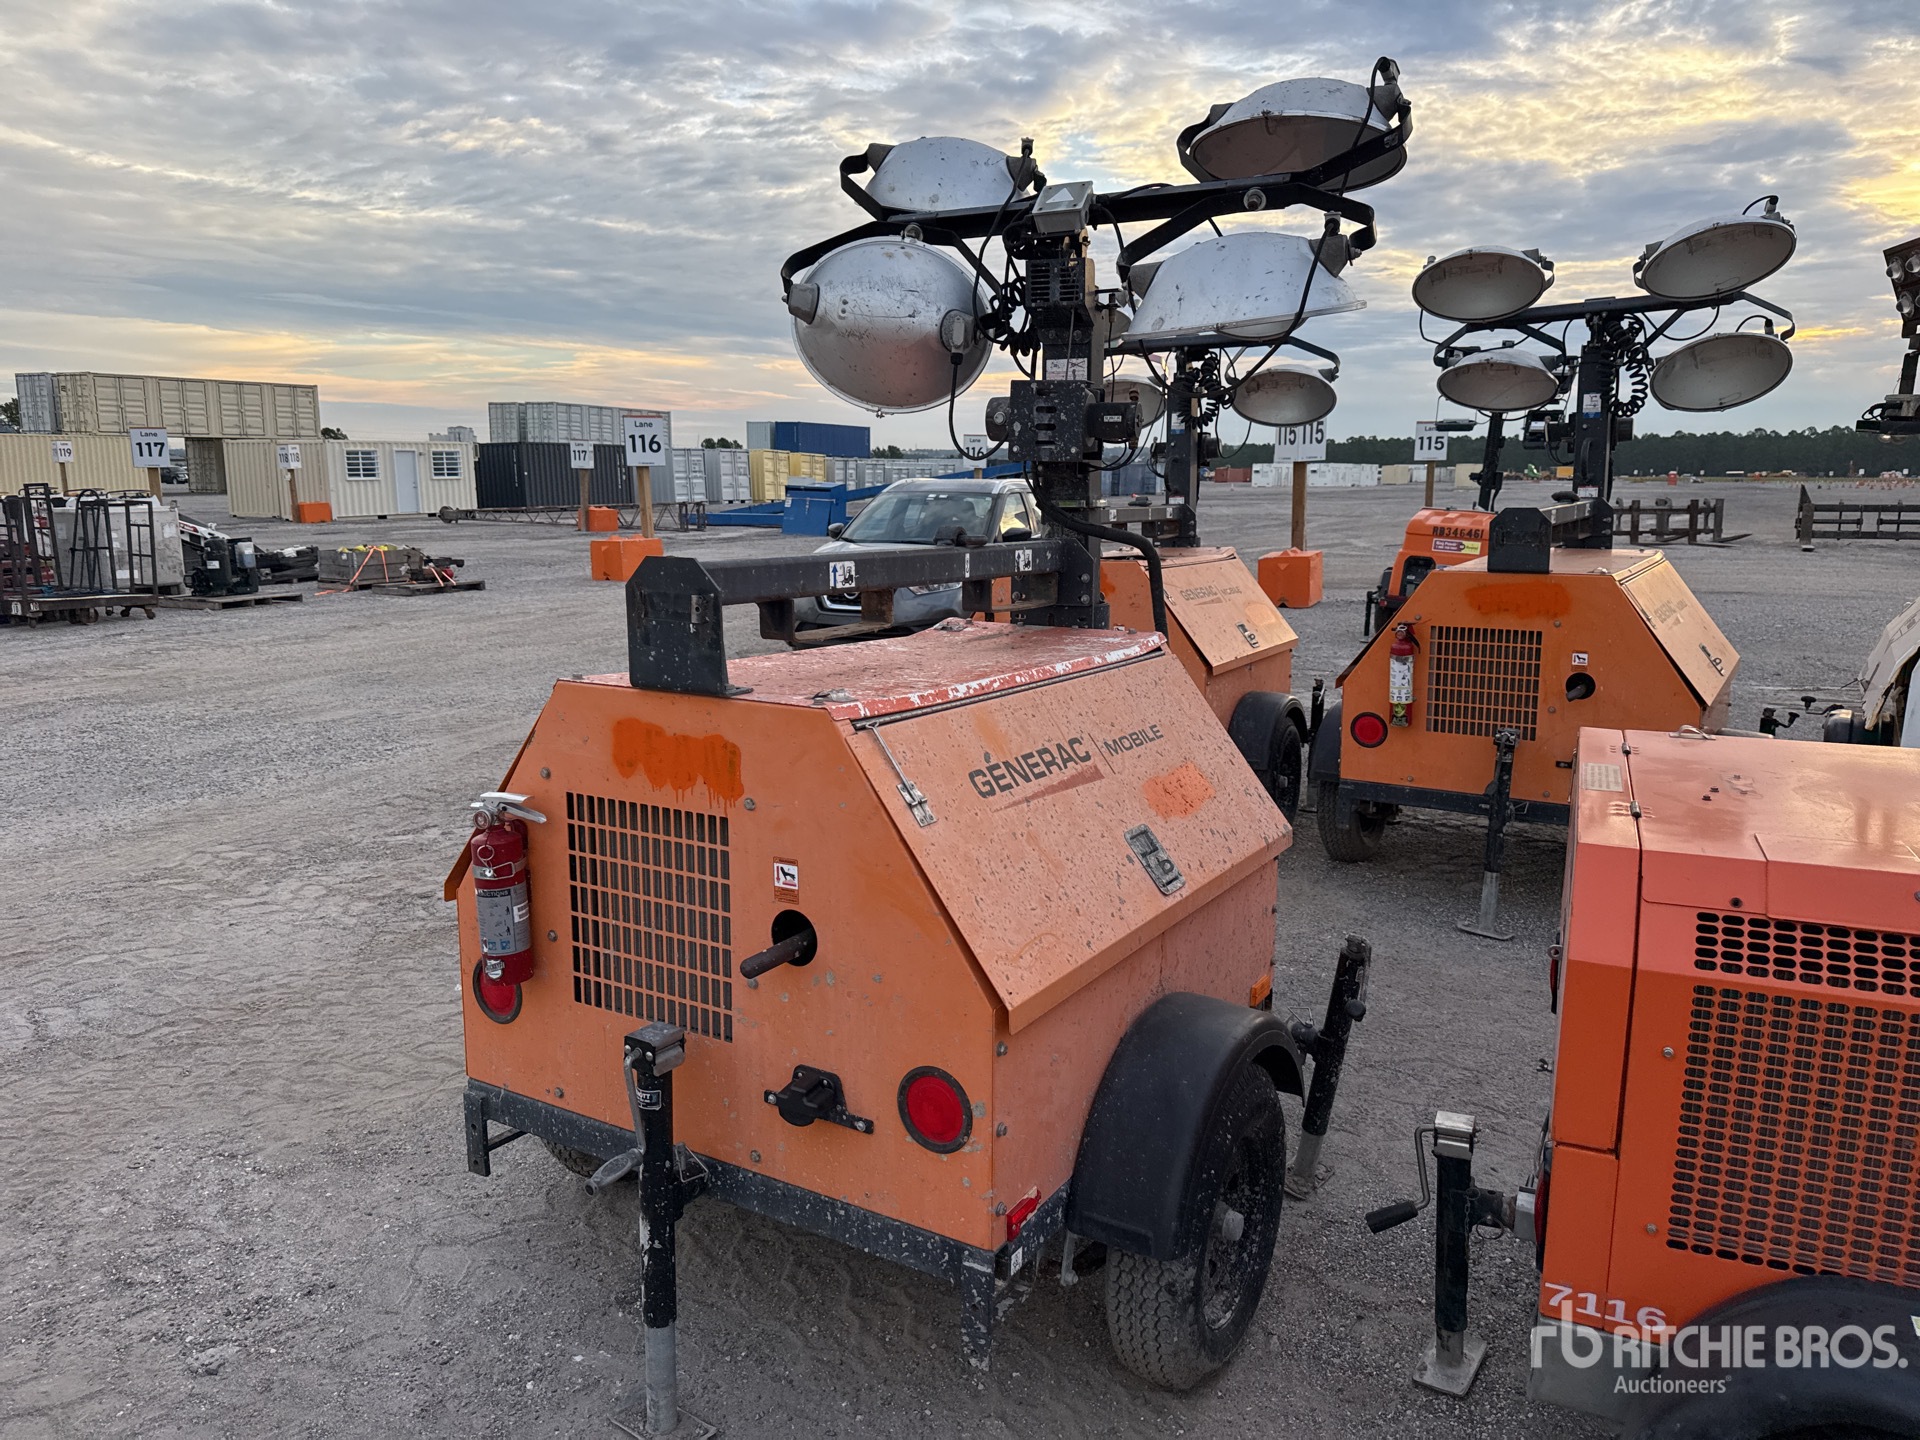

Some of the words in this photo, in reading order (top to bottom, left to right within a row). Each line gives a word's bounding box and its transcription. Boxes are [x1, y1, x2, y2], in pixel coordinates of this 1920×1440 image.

[1303, 421, 1325, 445] 115
[135, 442, 165, 457] 117
[629, 434, 662, 453] 116
[1418, 436, 1445, 451] 115
[58, 448, 72, 457] 119
[279, 453, 289, 463] 118
[290, 453, 300, 462] 118
[572, 450, 587, 461] 117
[968, 737, 1092, 799] GENERAC
[1103, 724, 1164, 757] MOBILE
[1544, 1282, 1667, 1332] 7116
